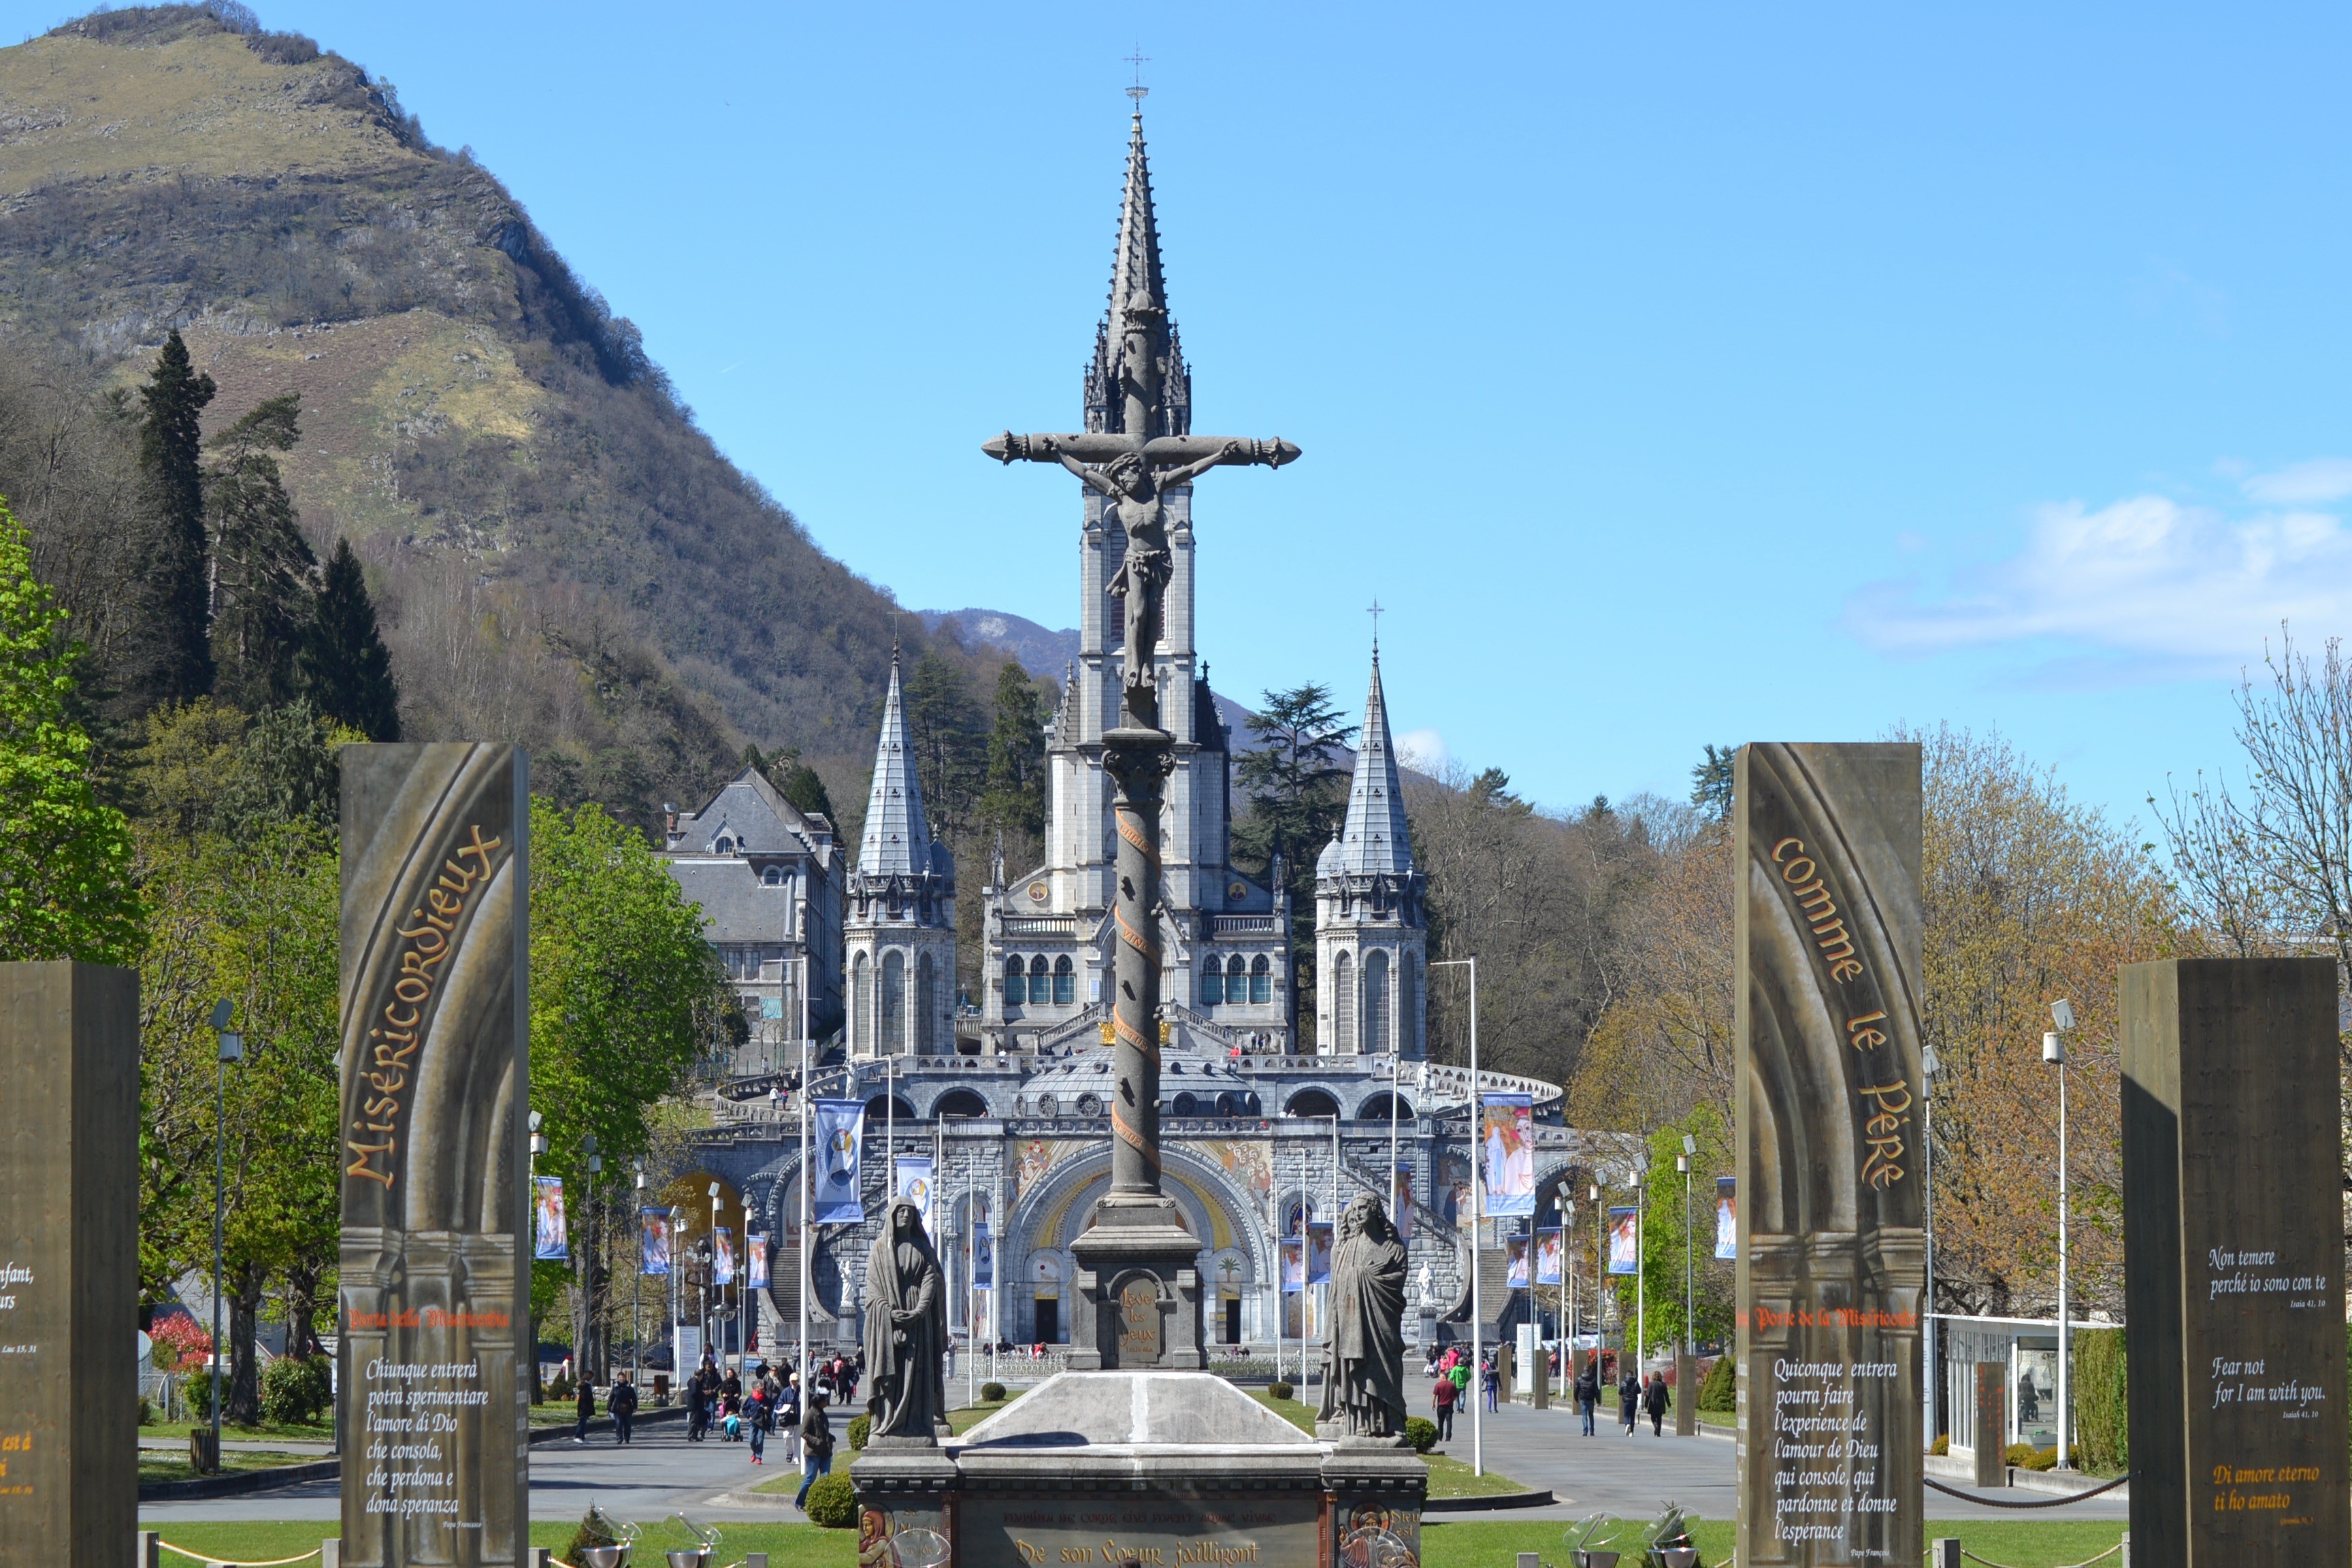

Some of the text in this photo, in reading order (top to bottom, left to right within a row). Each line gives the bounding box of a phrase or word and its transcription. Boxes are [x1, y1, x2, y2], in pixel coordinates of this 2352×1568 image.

[1771, 836, 1863, 984] comme
[1846, 1010, 1889, 1051] le
[2209, 1245, 2275, 1271] Non temere
[2210, 1272, 2326, 1300] perché io sono con te
[2290, 1300, 2305, 1308] Isaia
[348, 1309, 387, 1331] Porta
[1754, 1307, 1795, 1331] Porte
[1799, 1309, 1813, 1326] de
[1818, 1307, 1831, 1326] la
[366, 1356, 478, 1385] Chiunque entrerà
[1774, 1358, 1897, 1384] Quiconque entrera
[2212, 1357, 2265, 1379] Fear not
[368, 1385, 489, 1411] potrà sperimentare
[1776, 1383, 1854, 1411] pourra faire
[2212, 1379, 2325, 1409] for I am with you.
[366, 1411, 457, 1432] l'amore di Dio
[1852, 1410, 1867, 1431] de
[366, 1437, 442, 1461] che consola,
[1775, 1437, 1878, 1458] l'amour de Dieu
[366, 1465, 453, 1493] che perdona e
[1775, 1464, 1875, 1492] qui console, qui
[2213, 1465, 2319, 1484] Di amore eterno
[366, 1492, 459, 1519] dona speranza
[1776, 1490, 1897, 1519] pardonne et donne
[2215, 1489, 2290, 1511] ti ho amato
[1775, 1518, 1844, 1546] l'espérance
[1015, 1539, 1048, 1565] De
[1060, 1547, 1092, 1563] son
[1850, 1548, 1865, 1558] Pape
